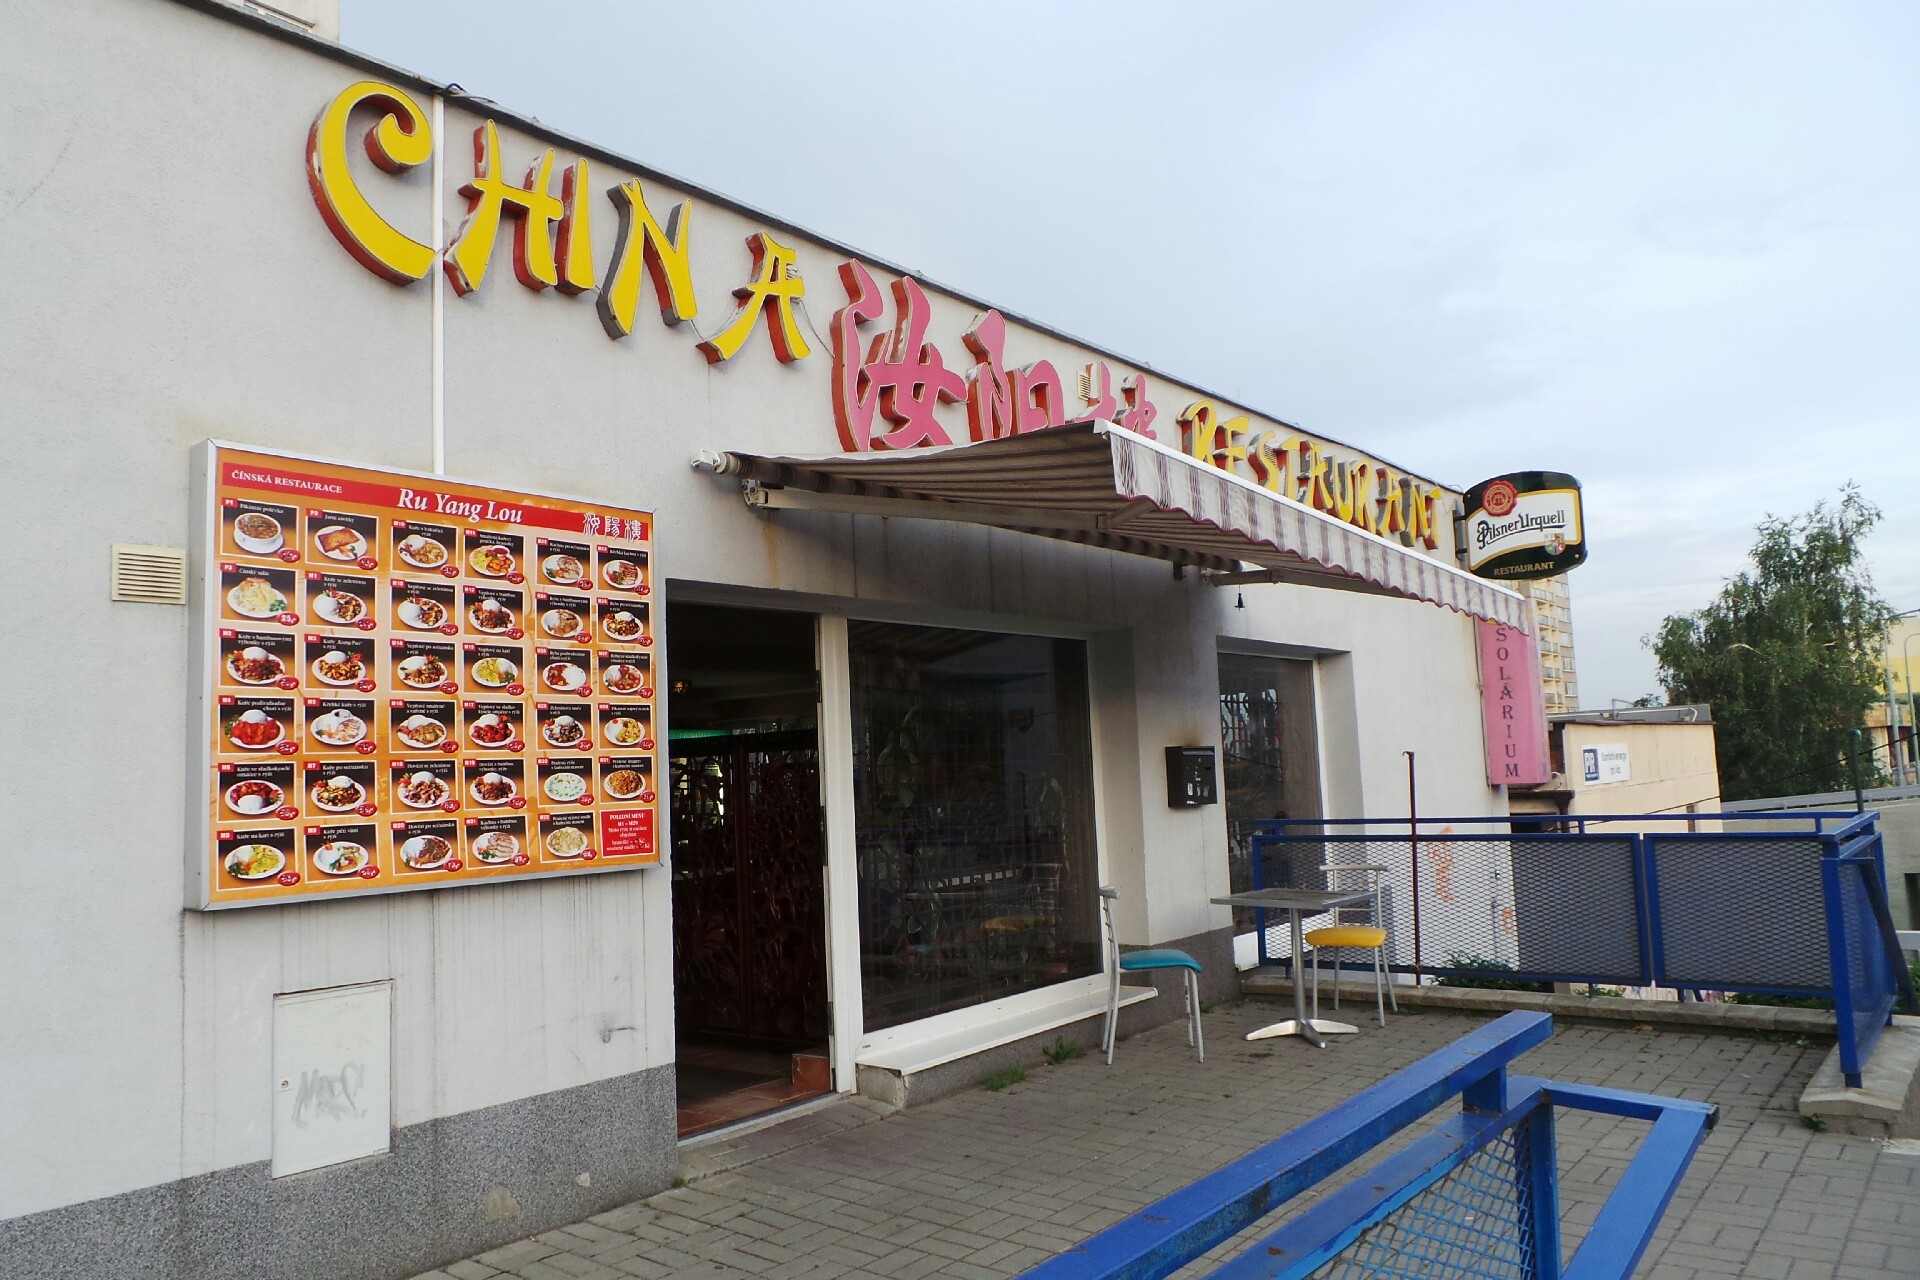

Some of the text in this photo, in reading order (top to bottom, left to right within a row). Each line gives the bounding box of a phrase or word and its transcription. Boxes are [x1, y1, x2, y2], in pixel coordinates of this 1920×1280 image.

[306, 80, 811, 364] CHINA
[231, 468, 342, 494] ČÍNSKÁ RESTAURACE
[1176, 400, 1441, 549] RESTAURANT
[396, 487, 522, 524] Ru Yang Lou
[1477, 510, 1565, 549] Pilsner Urquell
[1494, 561, 1555, 576] RESTAURANT
[1495, 627, 1520, 778] SOLÁRIUM
